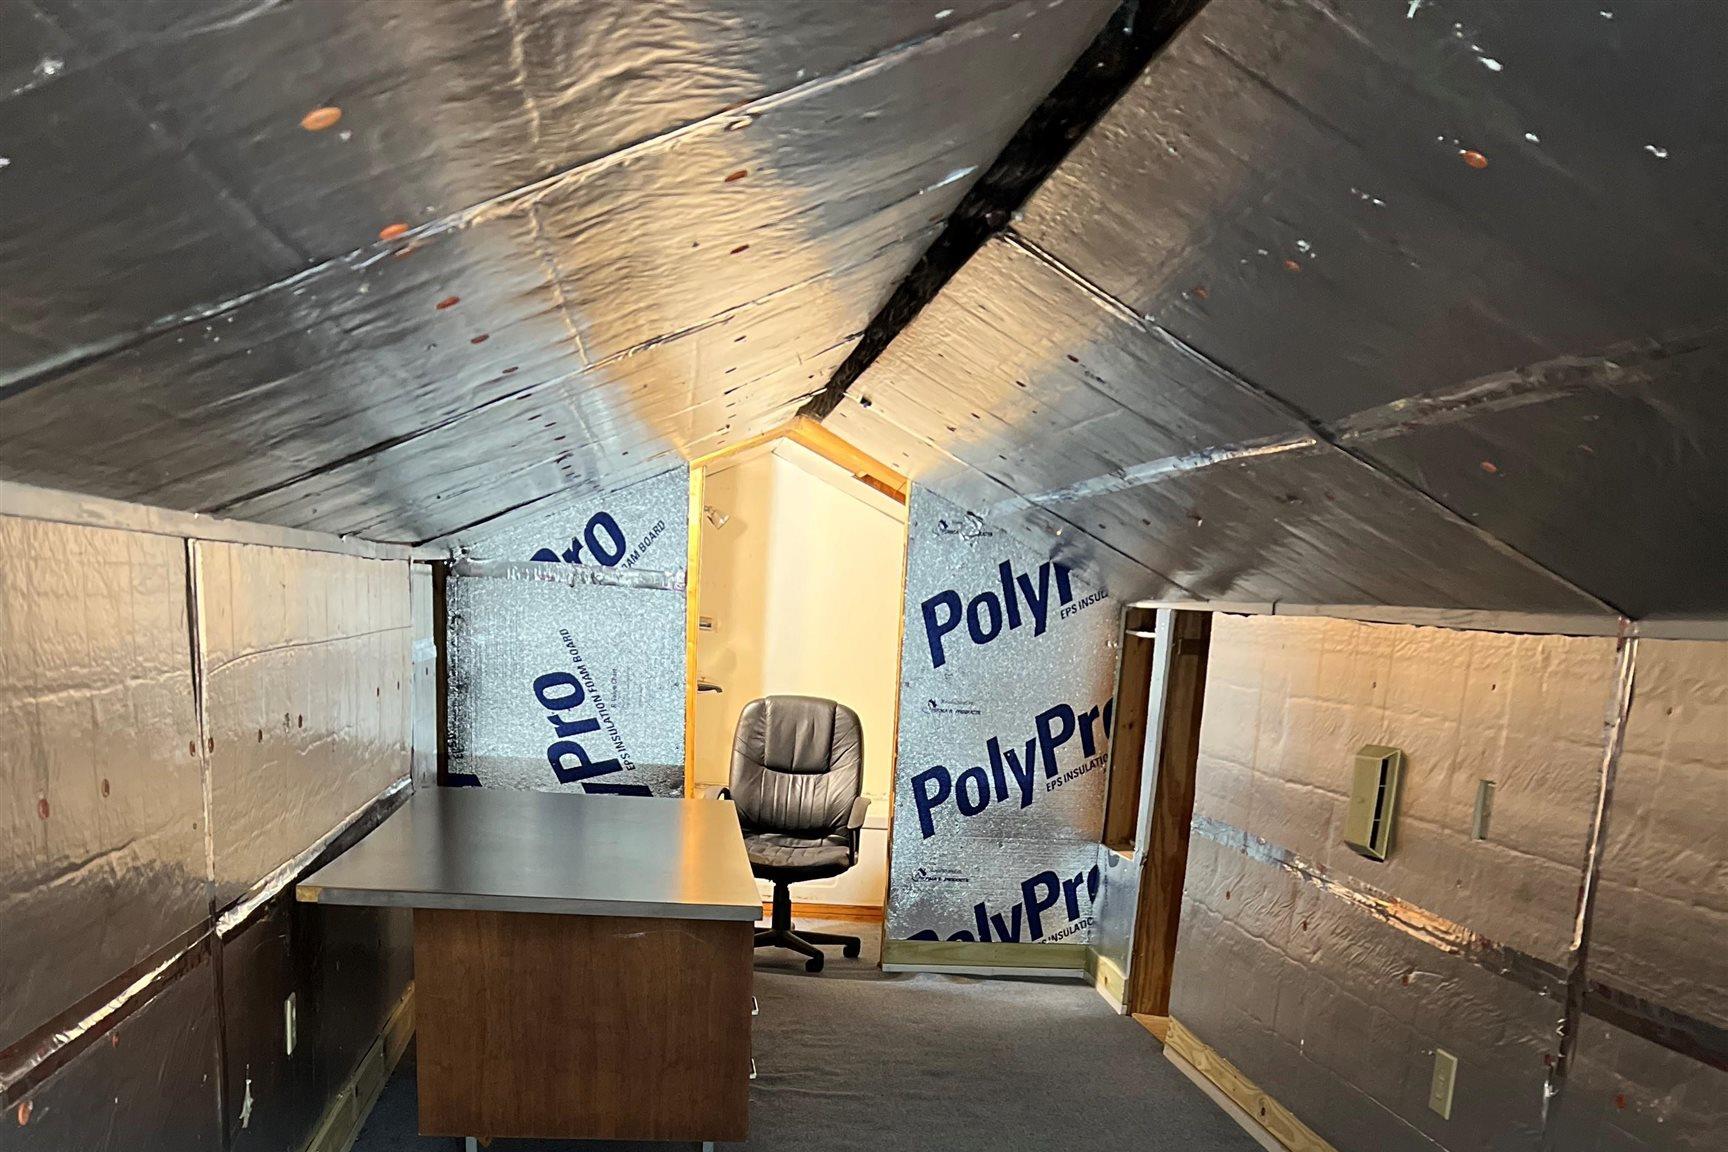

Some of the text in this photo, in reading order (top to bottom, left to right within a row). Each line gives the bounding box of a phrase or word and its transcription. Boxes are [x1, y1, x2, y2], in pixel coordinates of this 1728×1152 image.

[638, 520, 666, 553] BOARD
[1060, 603, 1078, 619] EPS
[560, 628, 636, 771] EPS INSULATION FOAM BOARD
[1046, 776, 1063, 792] EPS
